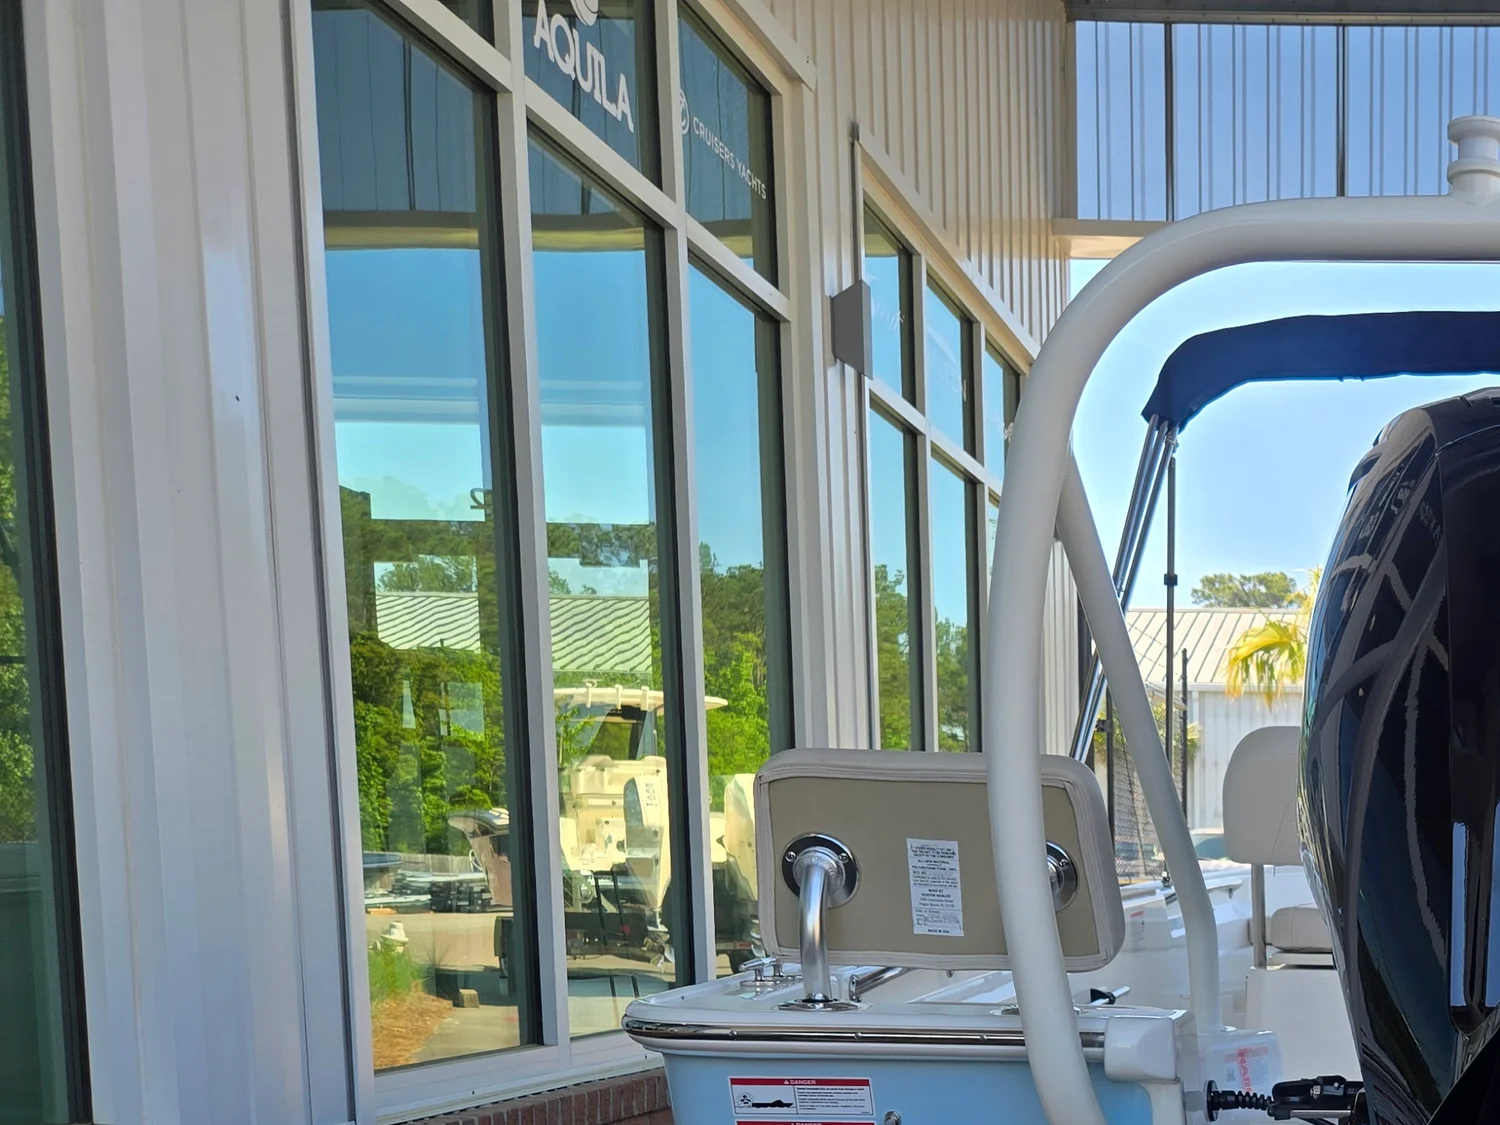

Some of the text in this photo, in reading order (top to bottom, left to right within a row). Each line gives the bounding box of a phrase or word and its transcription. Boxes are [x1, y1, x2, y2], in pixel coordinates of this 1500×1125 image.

[533, 0, 634, 133] AQUILA
[692, 115, 767, 200] CRUISERS YACHTS
